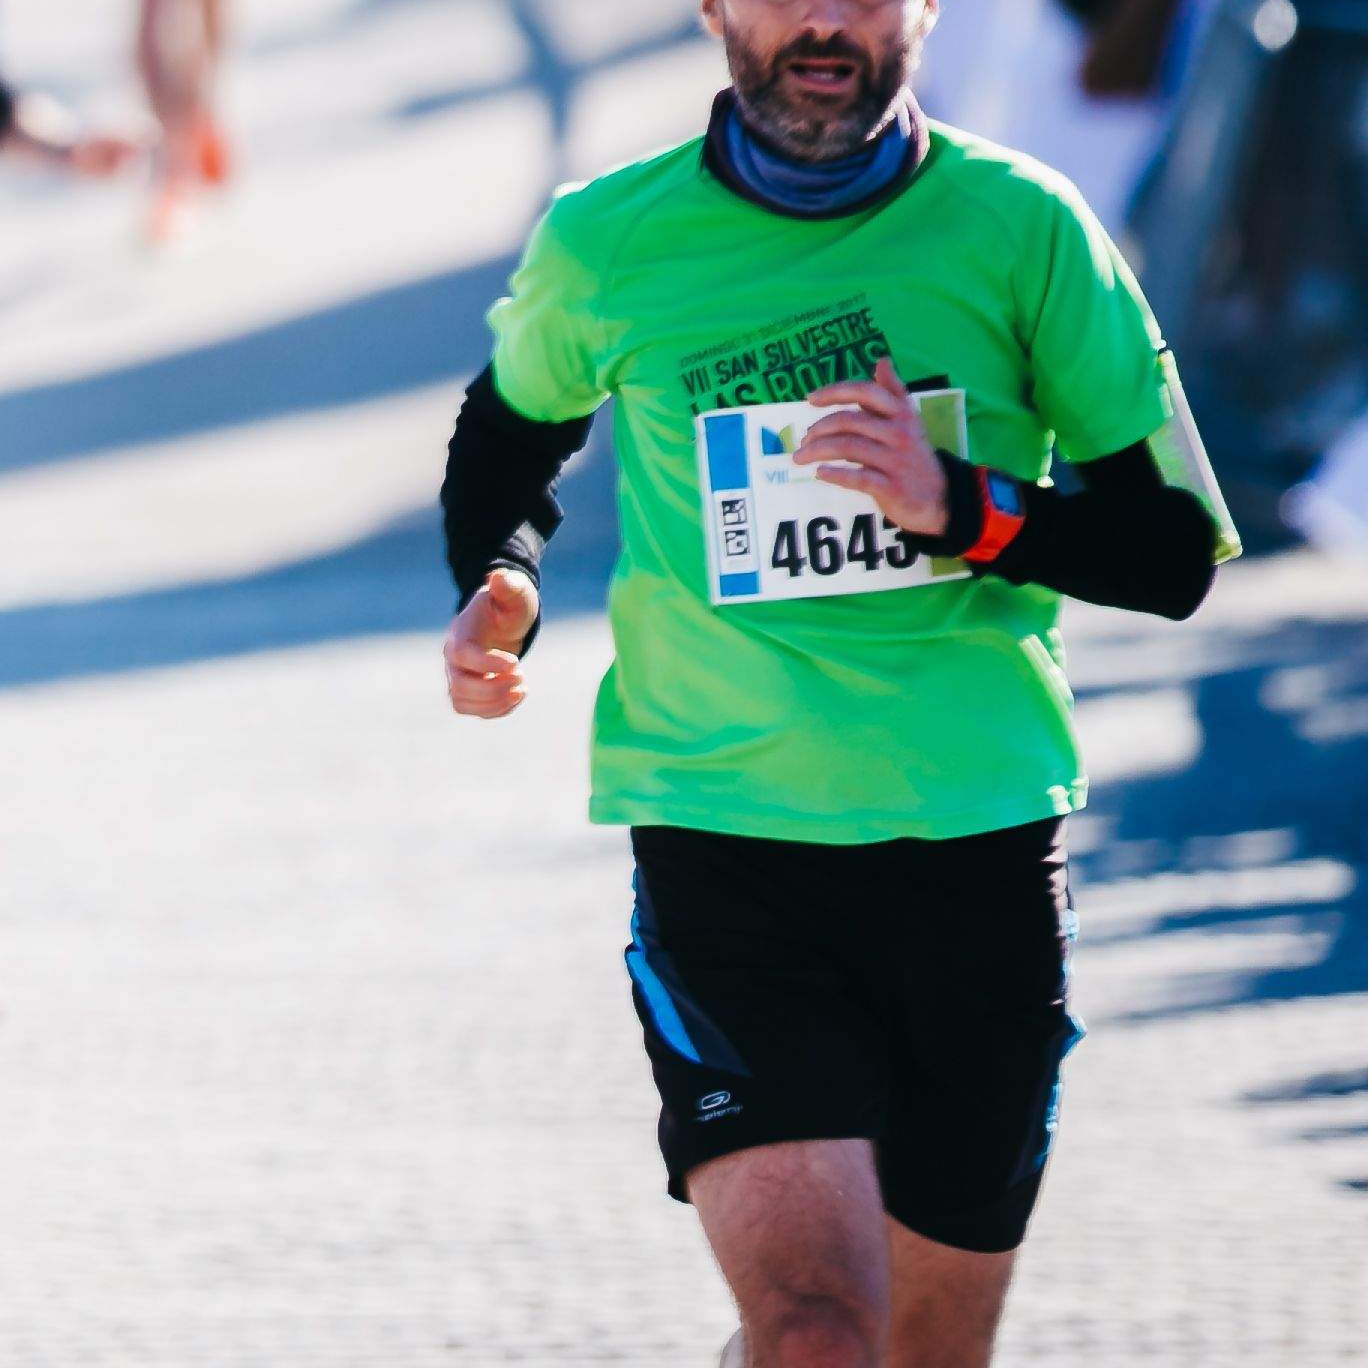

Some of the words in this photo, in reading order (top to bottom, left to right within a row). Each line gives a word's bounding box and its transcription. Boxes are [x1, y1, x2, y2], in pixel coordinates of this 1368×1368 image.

[680, 366, 712, 396] VII
[715, 349, 760, 385] SAN
[764, 307, 876, 369] SILVESTRE
